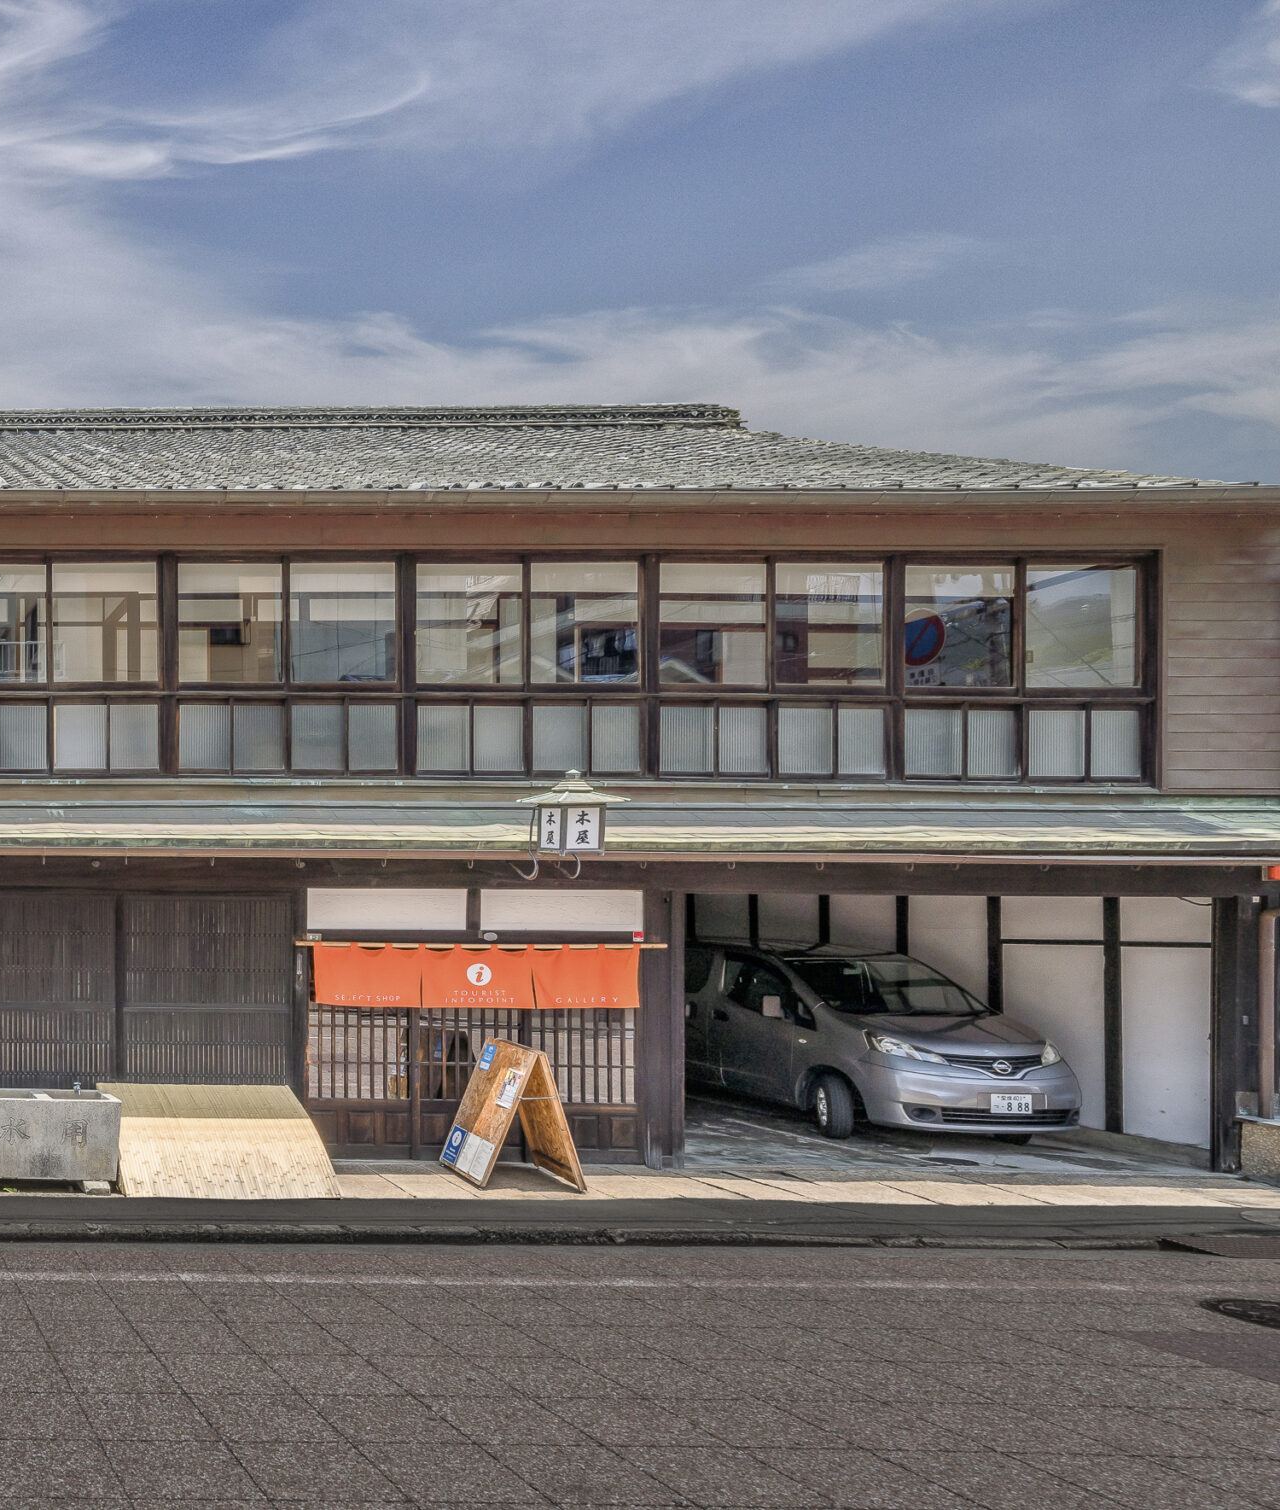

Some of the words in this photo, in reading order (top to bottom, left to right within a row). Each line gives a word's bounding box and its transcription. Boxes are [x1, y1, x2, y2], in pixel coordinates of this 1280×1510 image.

[546, 811, 556, 845] 木屋
[575, 810, 591, 845] 木屋
[453, 989, 506, 997] TOURIST
[555, 996, 619, 1004] GALLERY
